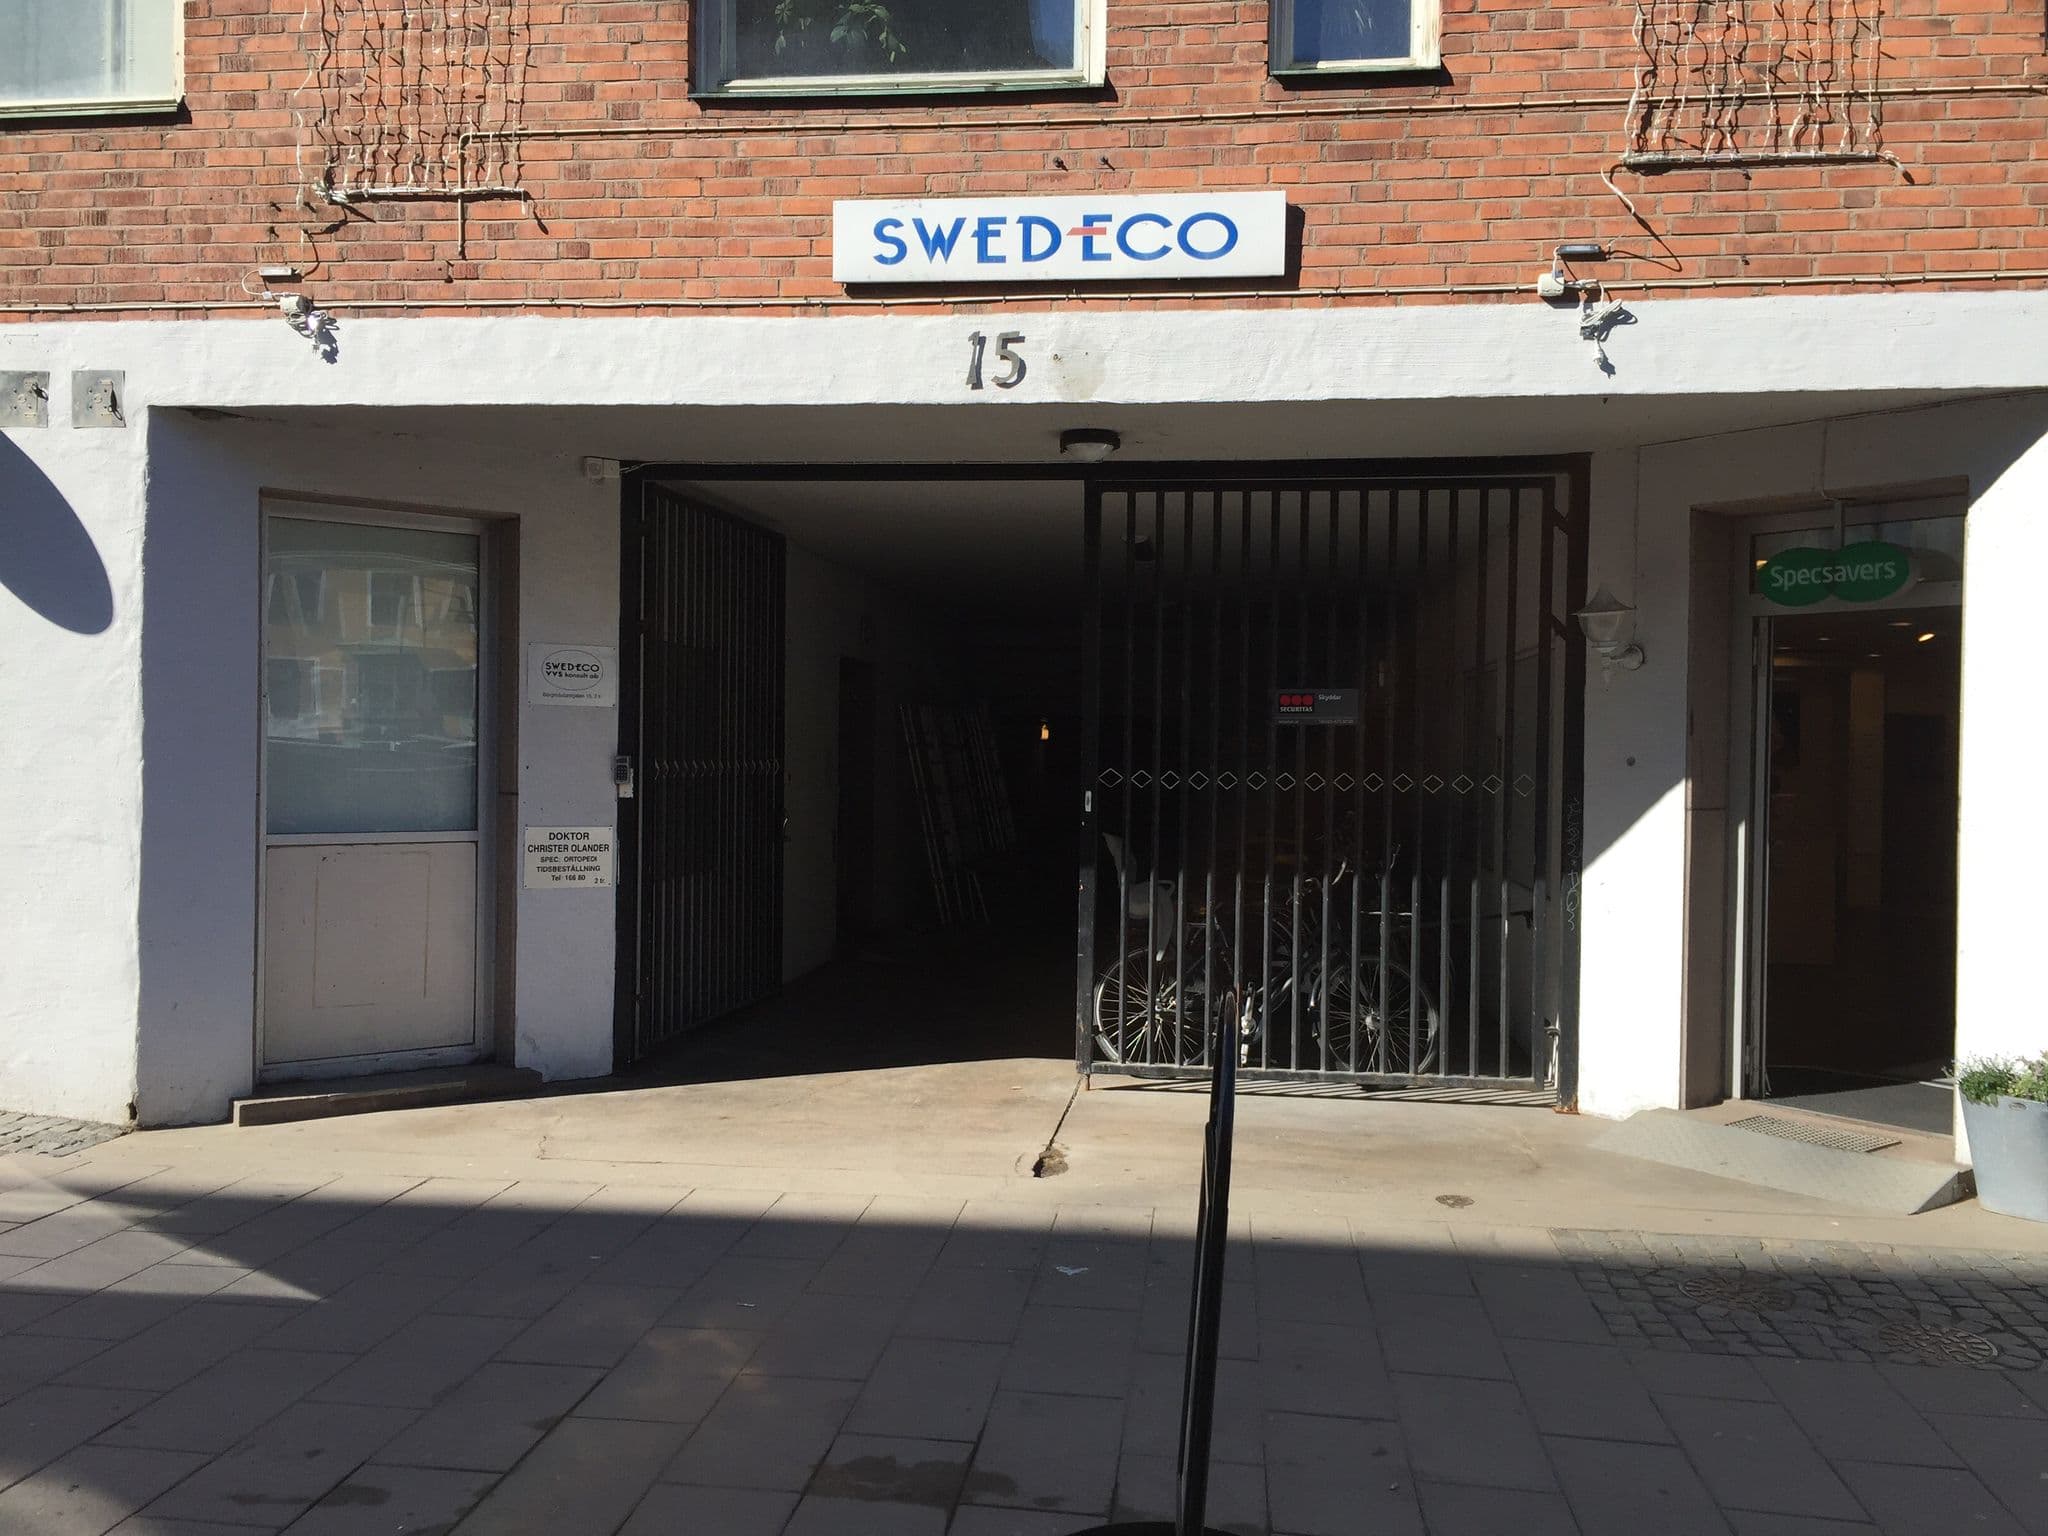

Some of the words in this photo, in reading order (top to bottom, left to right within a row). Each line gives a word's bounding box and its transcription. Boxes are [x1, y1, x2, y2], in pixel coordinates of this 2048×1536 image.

[873, 211, 1239, 265] SWEDECO
[965, 330, 1026, 388] 15
[1770, 561, 1897, 591] Specsavers
[545, 662, 600, 672] SWEDECO
[549, 832, 590, 840] DOKTOR
[527, 844, 569, 853] CHRISTER
[570, 843, 610, 853] OLANDER
[563, 855, 598, 863] ORTOPEDI
